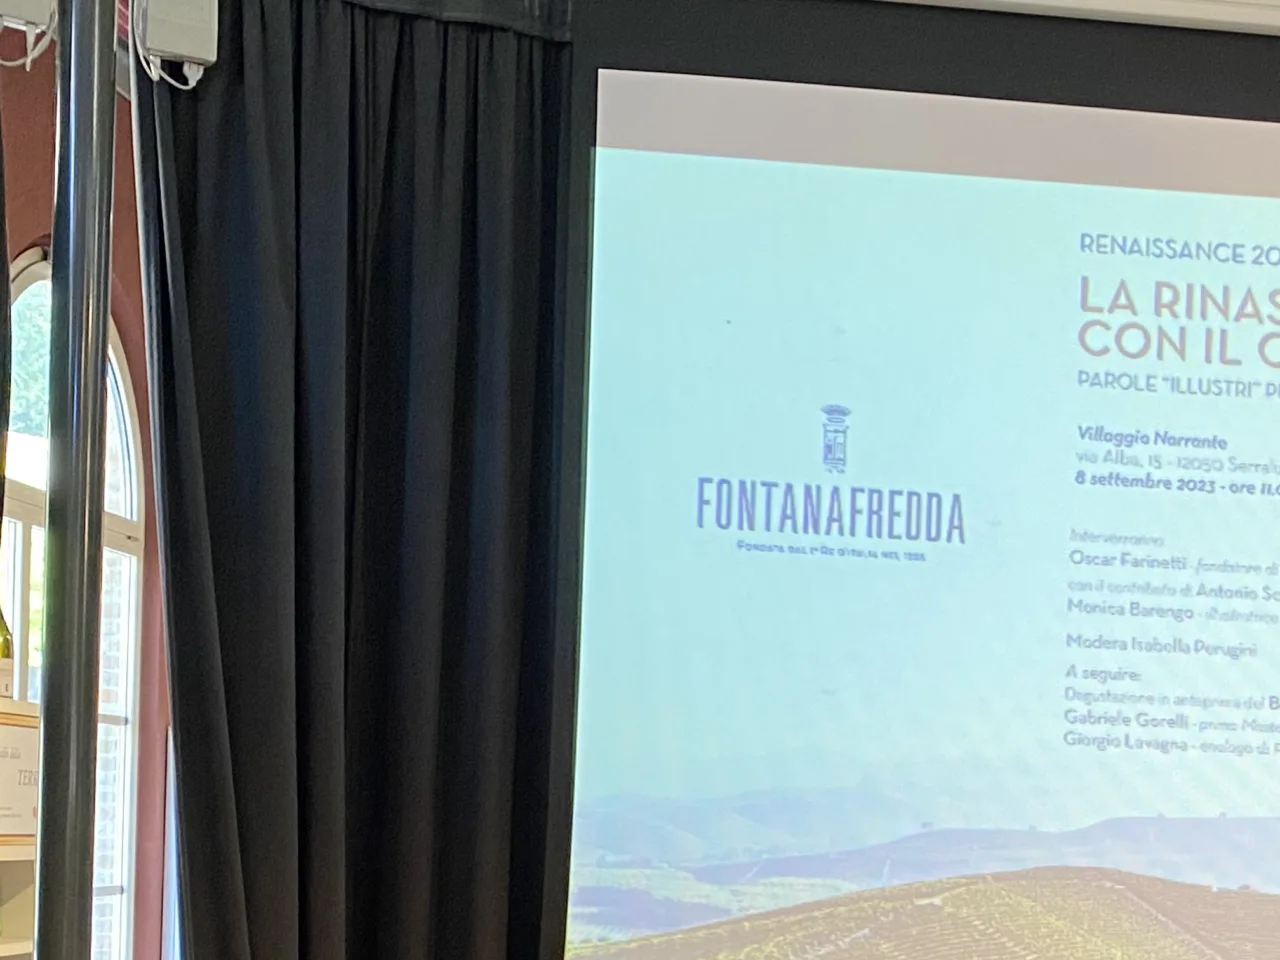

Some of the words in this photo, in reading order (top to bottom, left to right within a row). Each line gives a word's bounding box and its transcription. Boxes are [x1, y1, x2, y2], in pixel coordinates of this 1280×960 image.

[1079, 232, 1246, 265] RENAISSANCE
[1080, 275, 1137, 316] LA
[1077, 319, 1187, 364] CON
[1203, 327, 1242, 367] IL
[1077, 369, 1158, 394] PAROLE
[1078, 425, 1150, 448] Villaggio
[1154, 431, 1228, 450] Narrante
[1074, 470, 1086, 485] 8
[1090, 471, 1172, 491] settembre
[1177, 479, 1216, 495] 2023
[1229, 483, 1256, 496] ore
[697, 477, 965, 544] FONTANAFREDDA
[1069, 550, 1117, 567] Oscar
[1120, 551, 1187, 571] Farinetti
[1196, 582, 1258, 600] Antonio
[1067, 597, 1125, 616] Monica
[1129, 601, 1195, 623] Barengo
[1066, 632, 1129, 651] Modera
[1132, 636, 1191, 654] Isabella
[1194, 640, 1258, 660] Perugini
[1065, 664, 1078, 678] A
[1063, 708, 1132, 727] Gabriele
[1135, 712, 1189, 729] Gorelli
[1062, 730, 1121, 751] Giorgio
[1124, 733, 1188, 754] Lavagna
